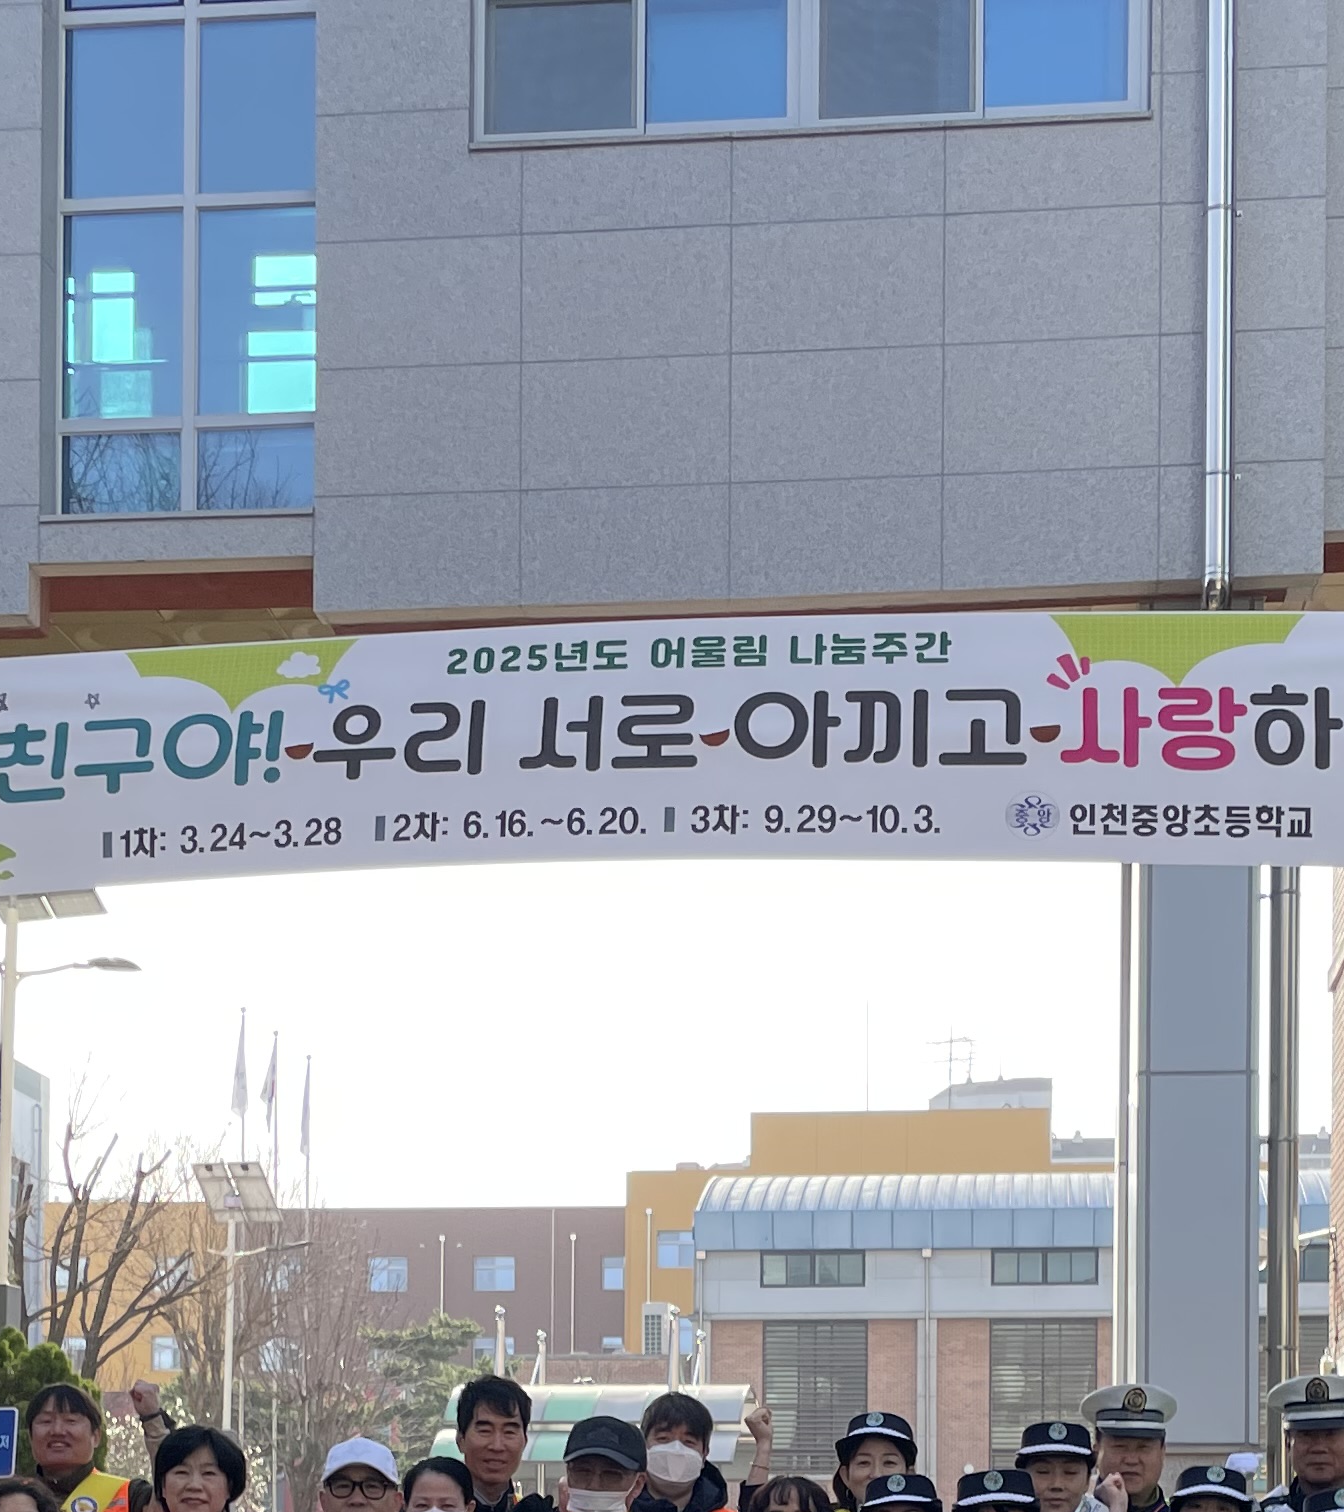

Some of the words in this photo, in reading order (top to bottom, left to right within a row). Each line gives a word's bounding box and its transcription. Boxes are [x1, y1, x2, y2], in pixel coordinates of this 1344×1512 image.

[447, 637, 628, 675] 2025년도
[652, 634, 767, 669] 어울림
[788, 631, 953, 668] 나눔주간
[317, 700, 483, 780] 우리
[518, 694, 697, 774] 서로
[734, 689, 1028, 771] 아끼고
[120, 827, 167, 858] 1차:
[180, 817, 343, 855] 3.24~3.28
[393, 811, 449, 843] 2차:
[690, 803, 750, 836] 3차:
[764, 803, 941, 836] 9.29~10.3.
[1069, 803, 1315, 841] 인천중앙초등학교
